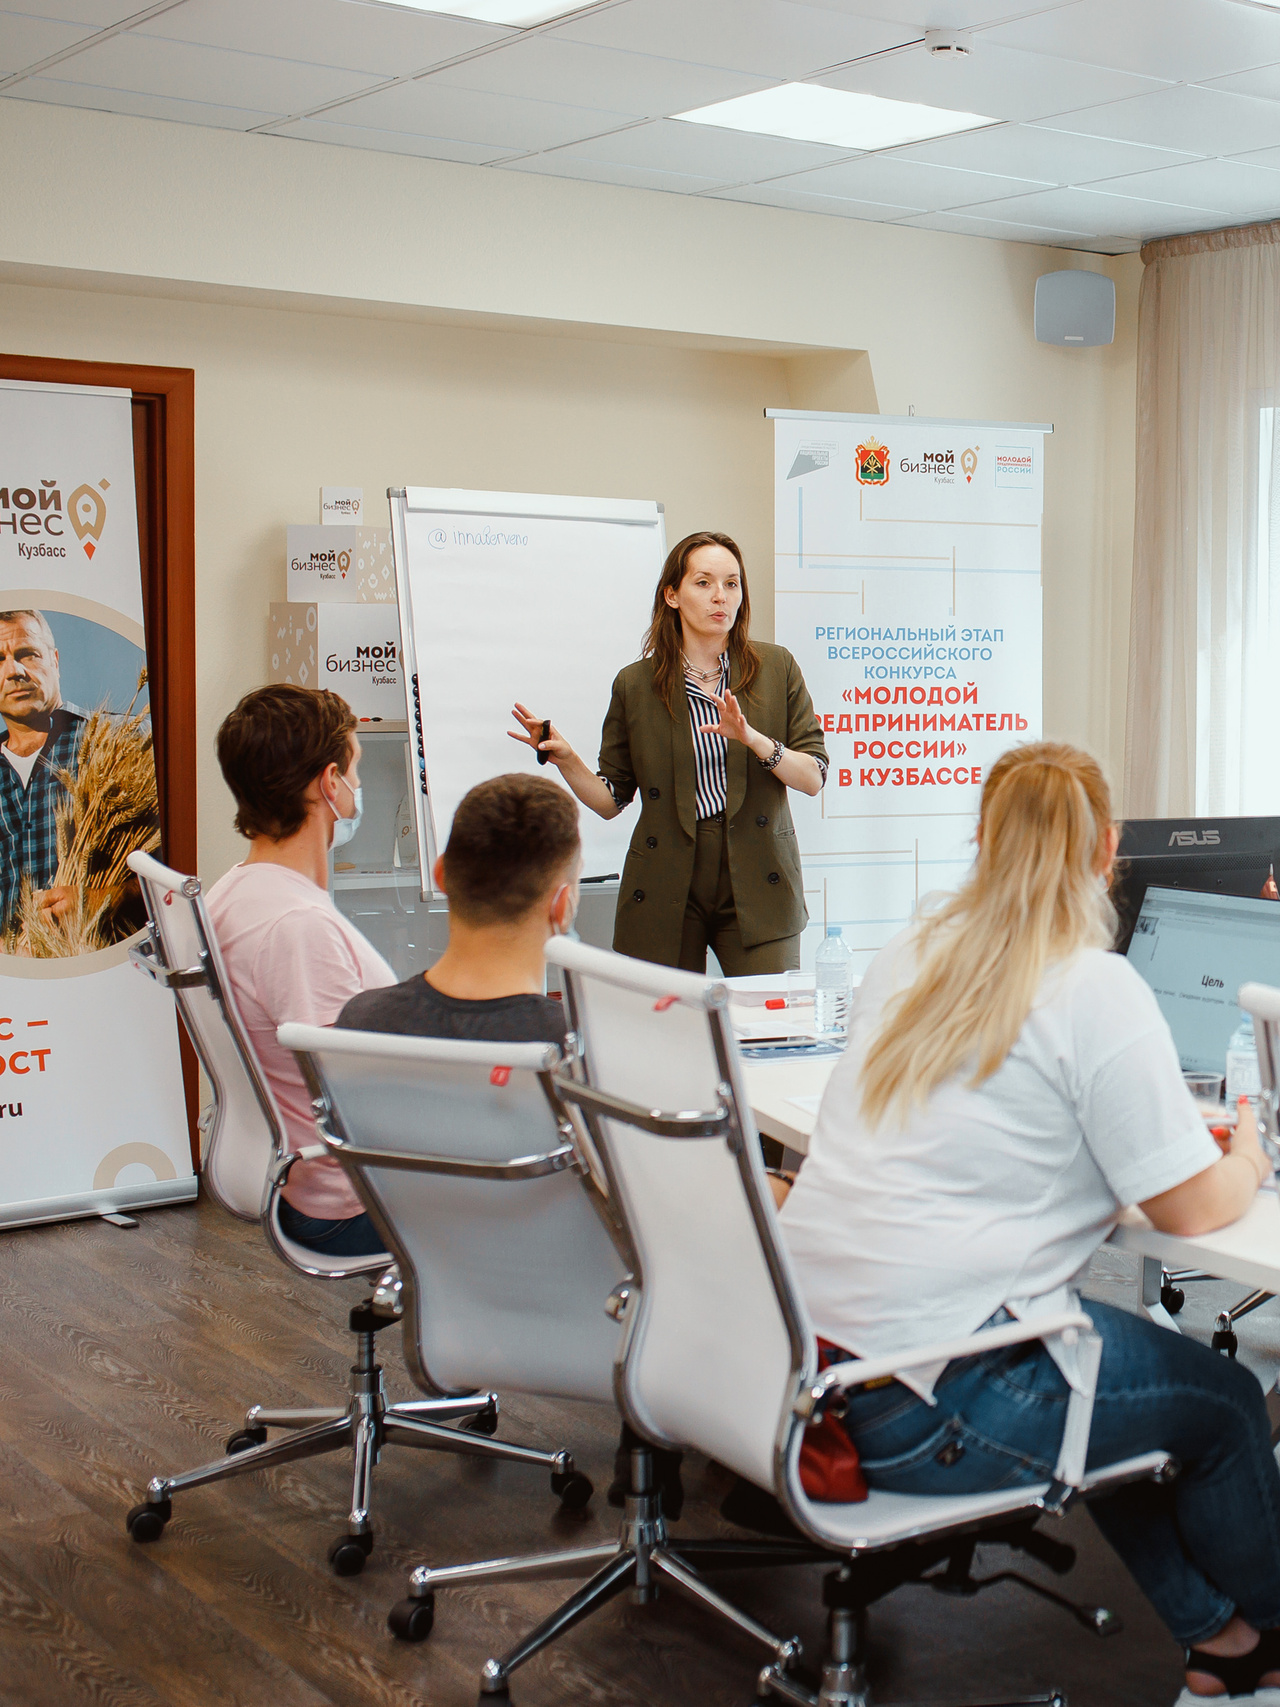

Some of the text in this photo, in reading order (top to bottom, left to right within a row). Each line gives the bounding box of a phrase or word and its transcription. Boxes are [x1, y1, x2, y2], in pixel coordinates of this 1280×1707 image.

[923, 450, 955, 463] мой
[900, 458, 955, 475] бизнес
[997, 466, 1032, 474] РОССИИ
[934, 476, 955, 485] Кузбасс
[323, 502, 351, 511] бизнес
[428, 528, 447, 550] @
[18, 543, 66, 560] Кузбасс
[310, 550, 336, 562] мой
[291, 557, 336, 572] бизнес
[815, 625, 1004, 642] РЕГИОНАЛЬНЫЙ ЭТАП
[356, 641, 396, 659] мой
[827, 644, 993, 661] ВСЕРОССИЙСКОГО
[326, 653, 397, 673] бизнес
[372, 676, 397, 686] Кузбасс
[864, 665, 957, 680] КОНКУРСА
[841, 681, 978, 707] «МОЛОДОЙ
[815, 713, 1029, 734] ЕДПРИНИМАТЕЛЬ
[853, 740, 967, 759] РОССИИ»
[838, 766, 982, 787] В КУЗБАССЕ
[1168, 829, 1221, 847] ASUS
[1201, 974, 1224, 989] Цель
[0, 1048, 52, 1075] СТ
